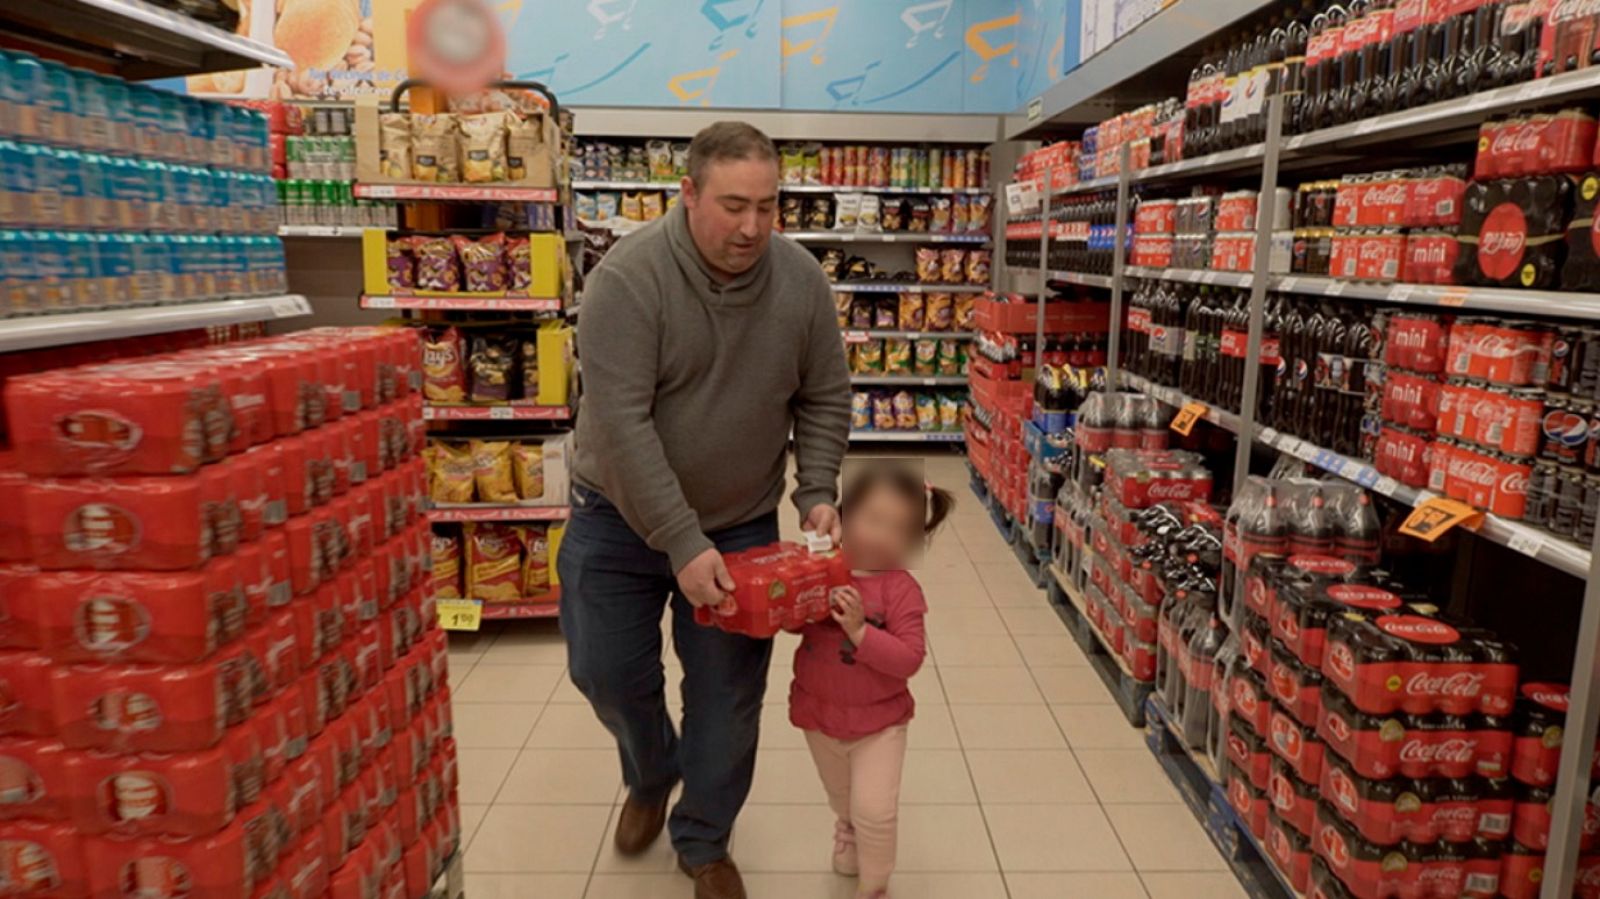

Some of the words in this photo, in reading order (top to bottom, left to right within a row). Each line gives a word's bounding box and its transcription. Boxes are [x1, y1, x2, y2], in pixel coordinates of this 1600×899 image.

[1413, 242, 1446, 263] mini
[1395, 328, 1428, 349] mini
[1391, 383, 1423, 405] mini
[1385, 440, 1416, 462] mini
[1406, 671, 1487, 697] Coca-Cola
[1399, 739, 1478, 763] Coca-Cola
